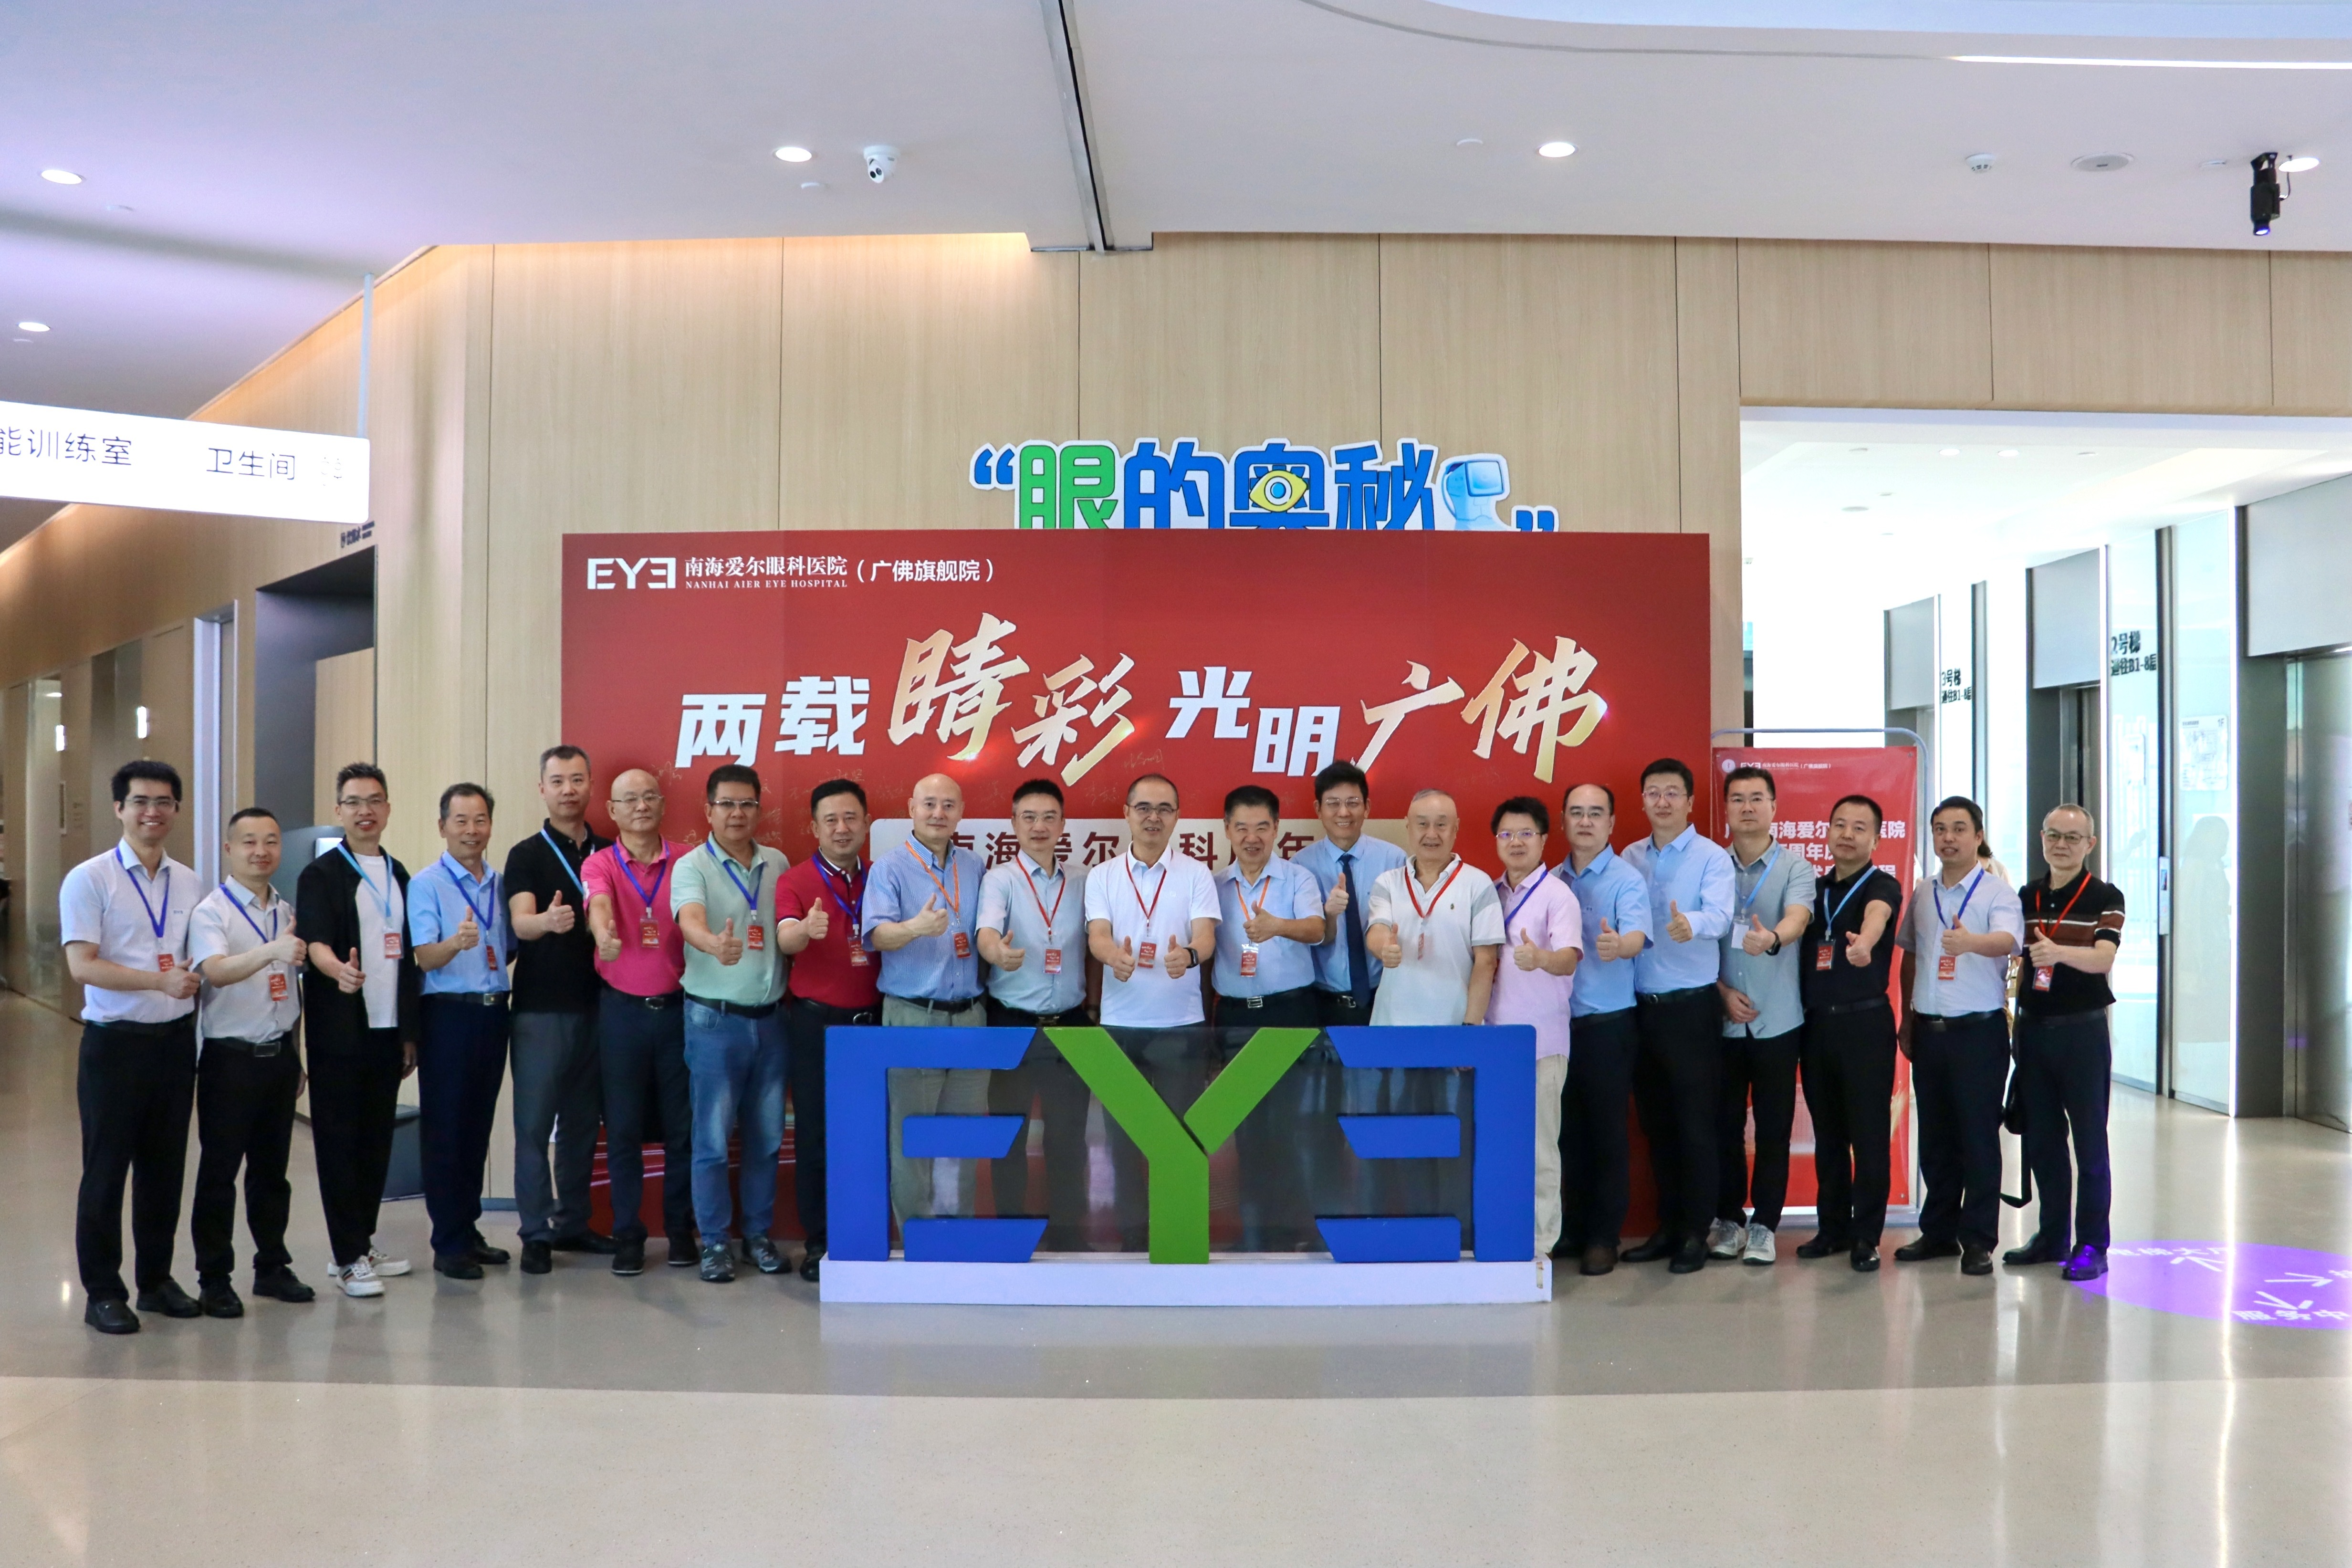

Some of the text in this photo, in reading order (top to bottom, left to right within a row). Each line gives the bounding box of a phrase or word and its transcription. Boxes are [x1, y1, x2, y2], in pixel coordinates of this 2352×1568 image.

[0, 427, 296, 480] 能训练室 卫生间
[587, 557, 676, 590] EYE
[685, 556, 847, 577] 南海爱尔眼科医院
[686, 579, 847, 589] NANHAI AIER EYE HOSPITAL
